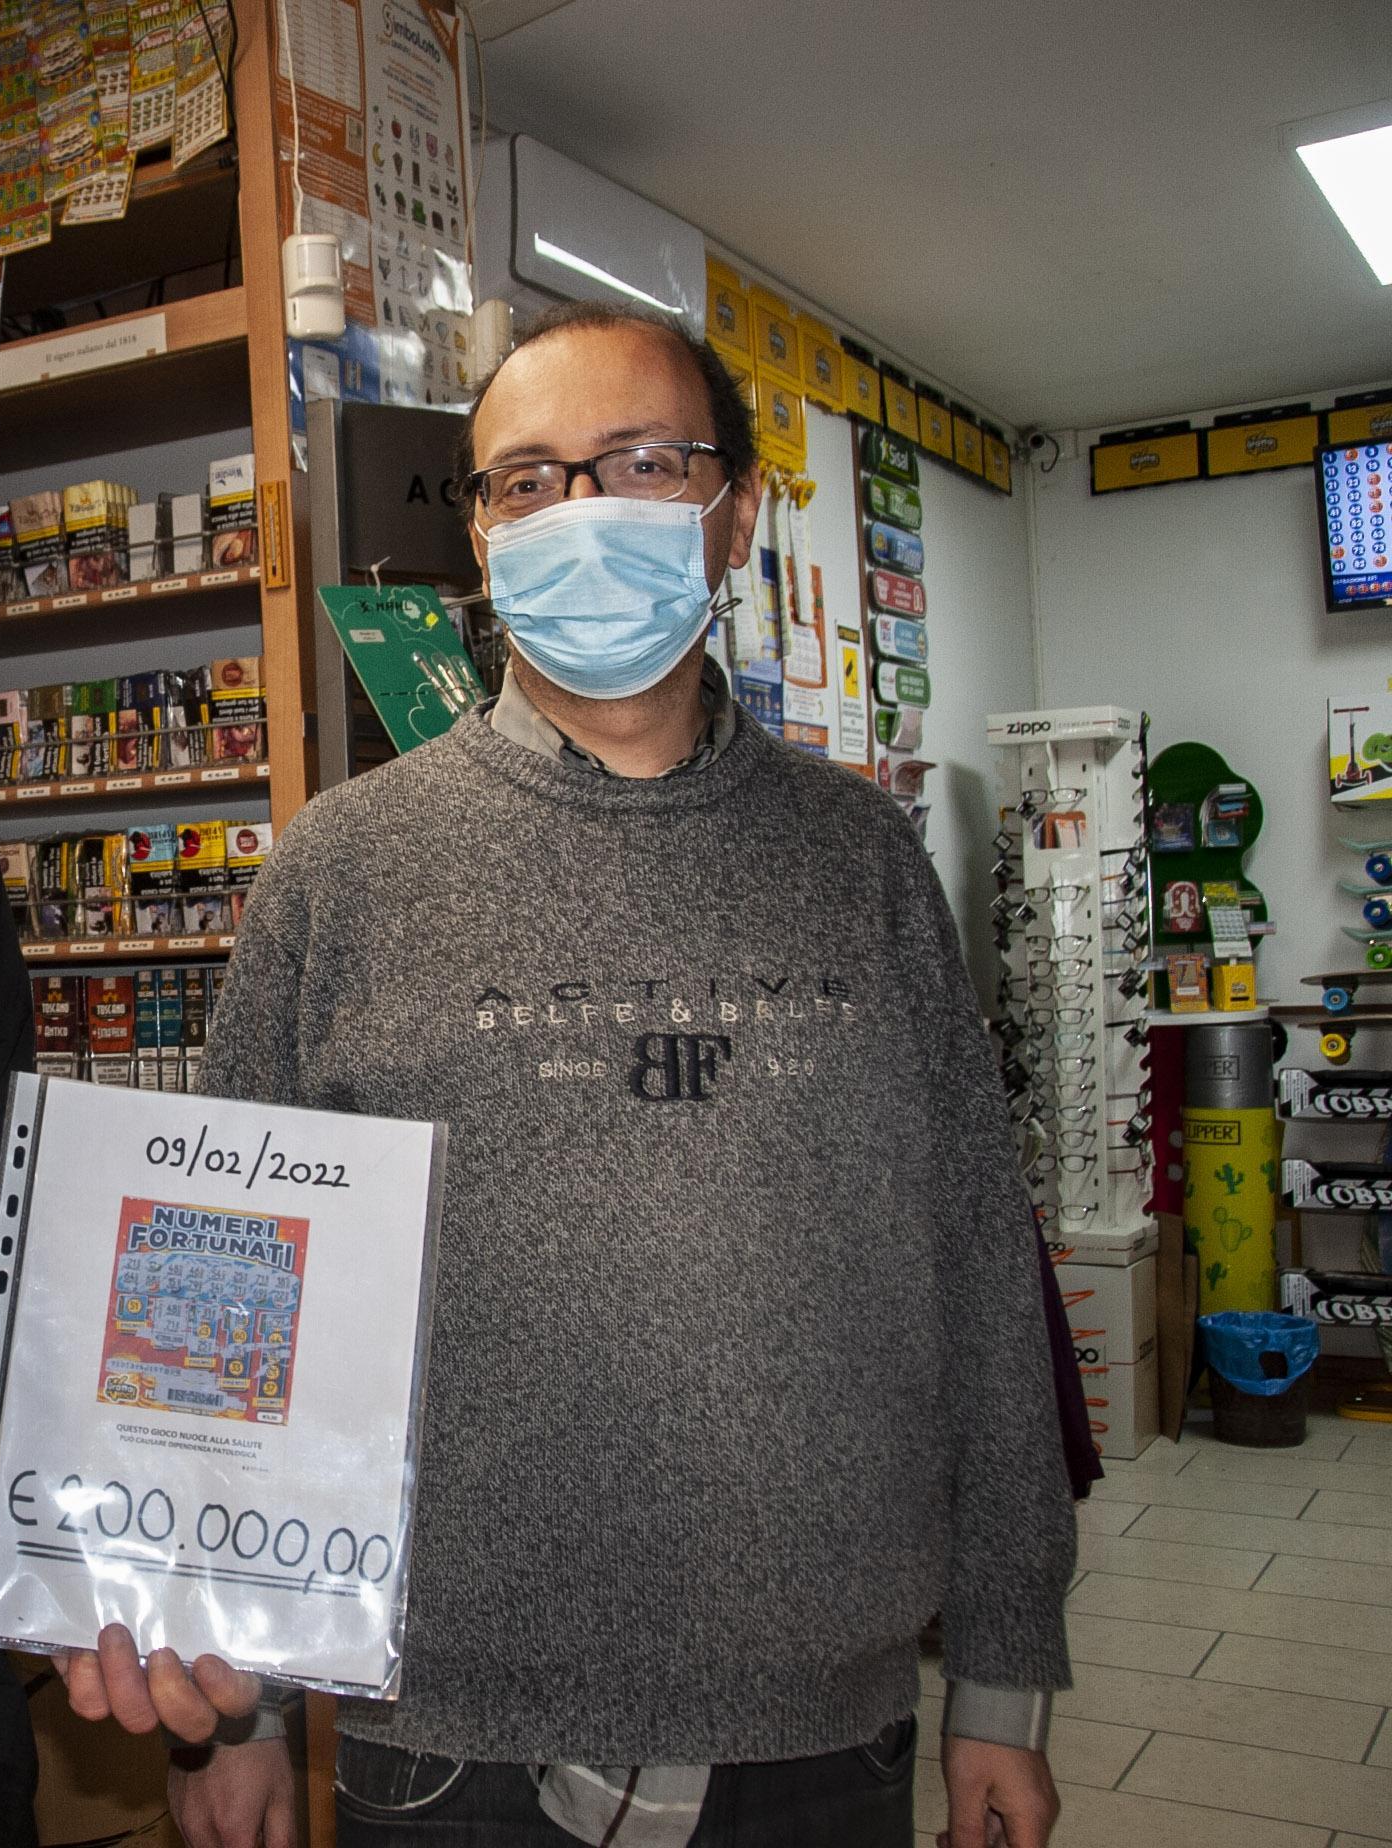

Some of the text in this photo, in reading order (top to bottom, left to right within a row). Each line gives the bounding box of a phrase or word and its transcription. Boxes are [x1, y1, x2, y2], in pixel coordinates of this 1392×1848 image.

[1007, 720, 1051, 736] zippo
[41, 1003, 70, 1014] TOSCANO
[97, 1003, 126, 1015] TOSCANO
[671, 998, 692, 1023] &
[146, 1125, 350, 1189] 09/02/2022
[154, 1207, 277, 1239] NUMERI
[129, 1224, 296, 1271] FORTUNATI
[116, 1424, 262, 1449] QUESTO GIOCO NUOCE ALLA SALUTE
[9, 1470, 393, 1594] € 200.000,00
